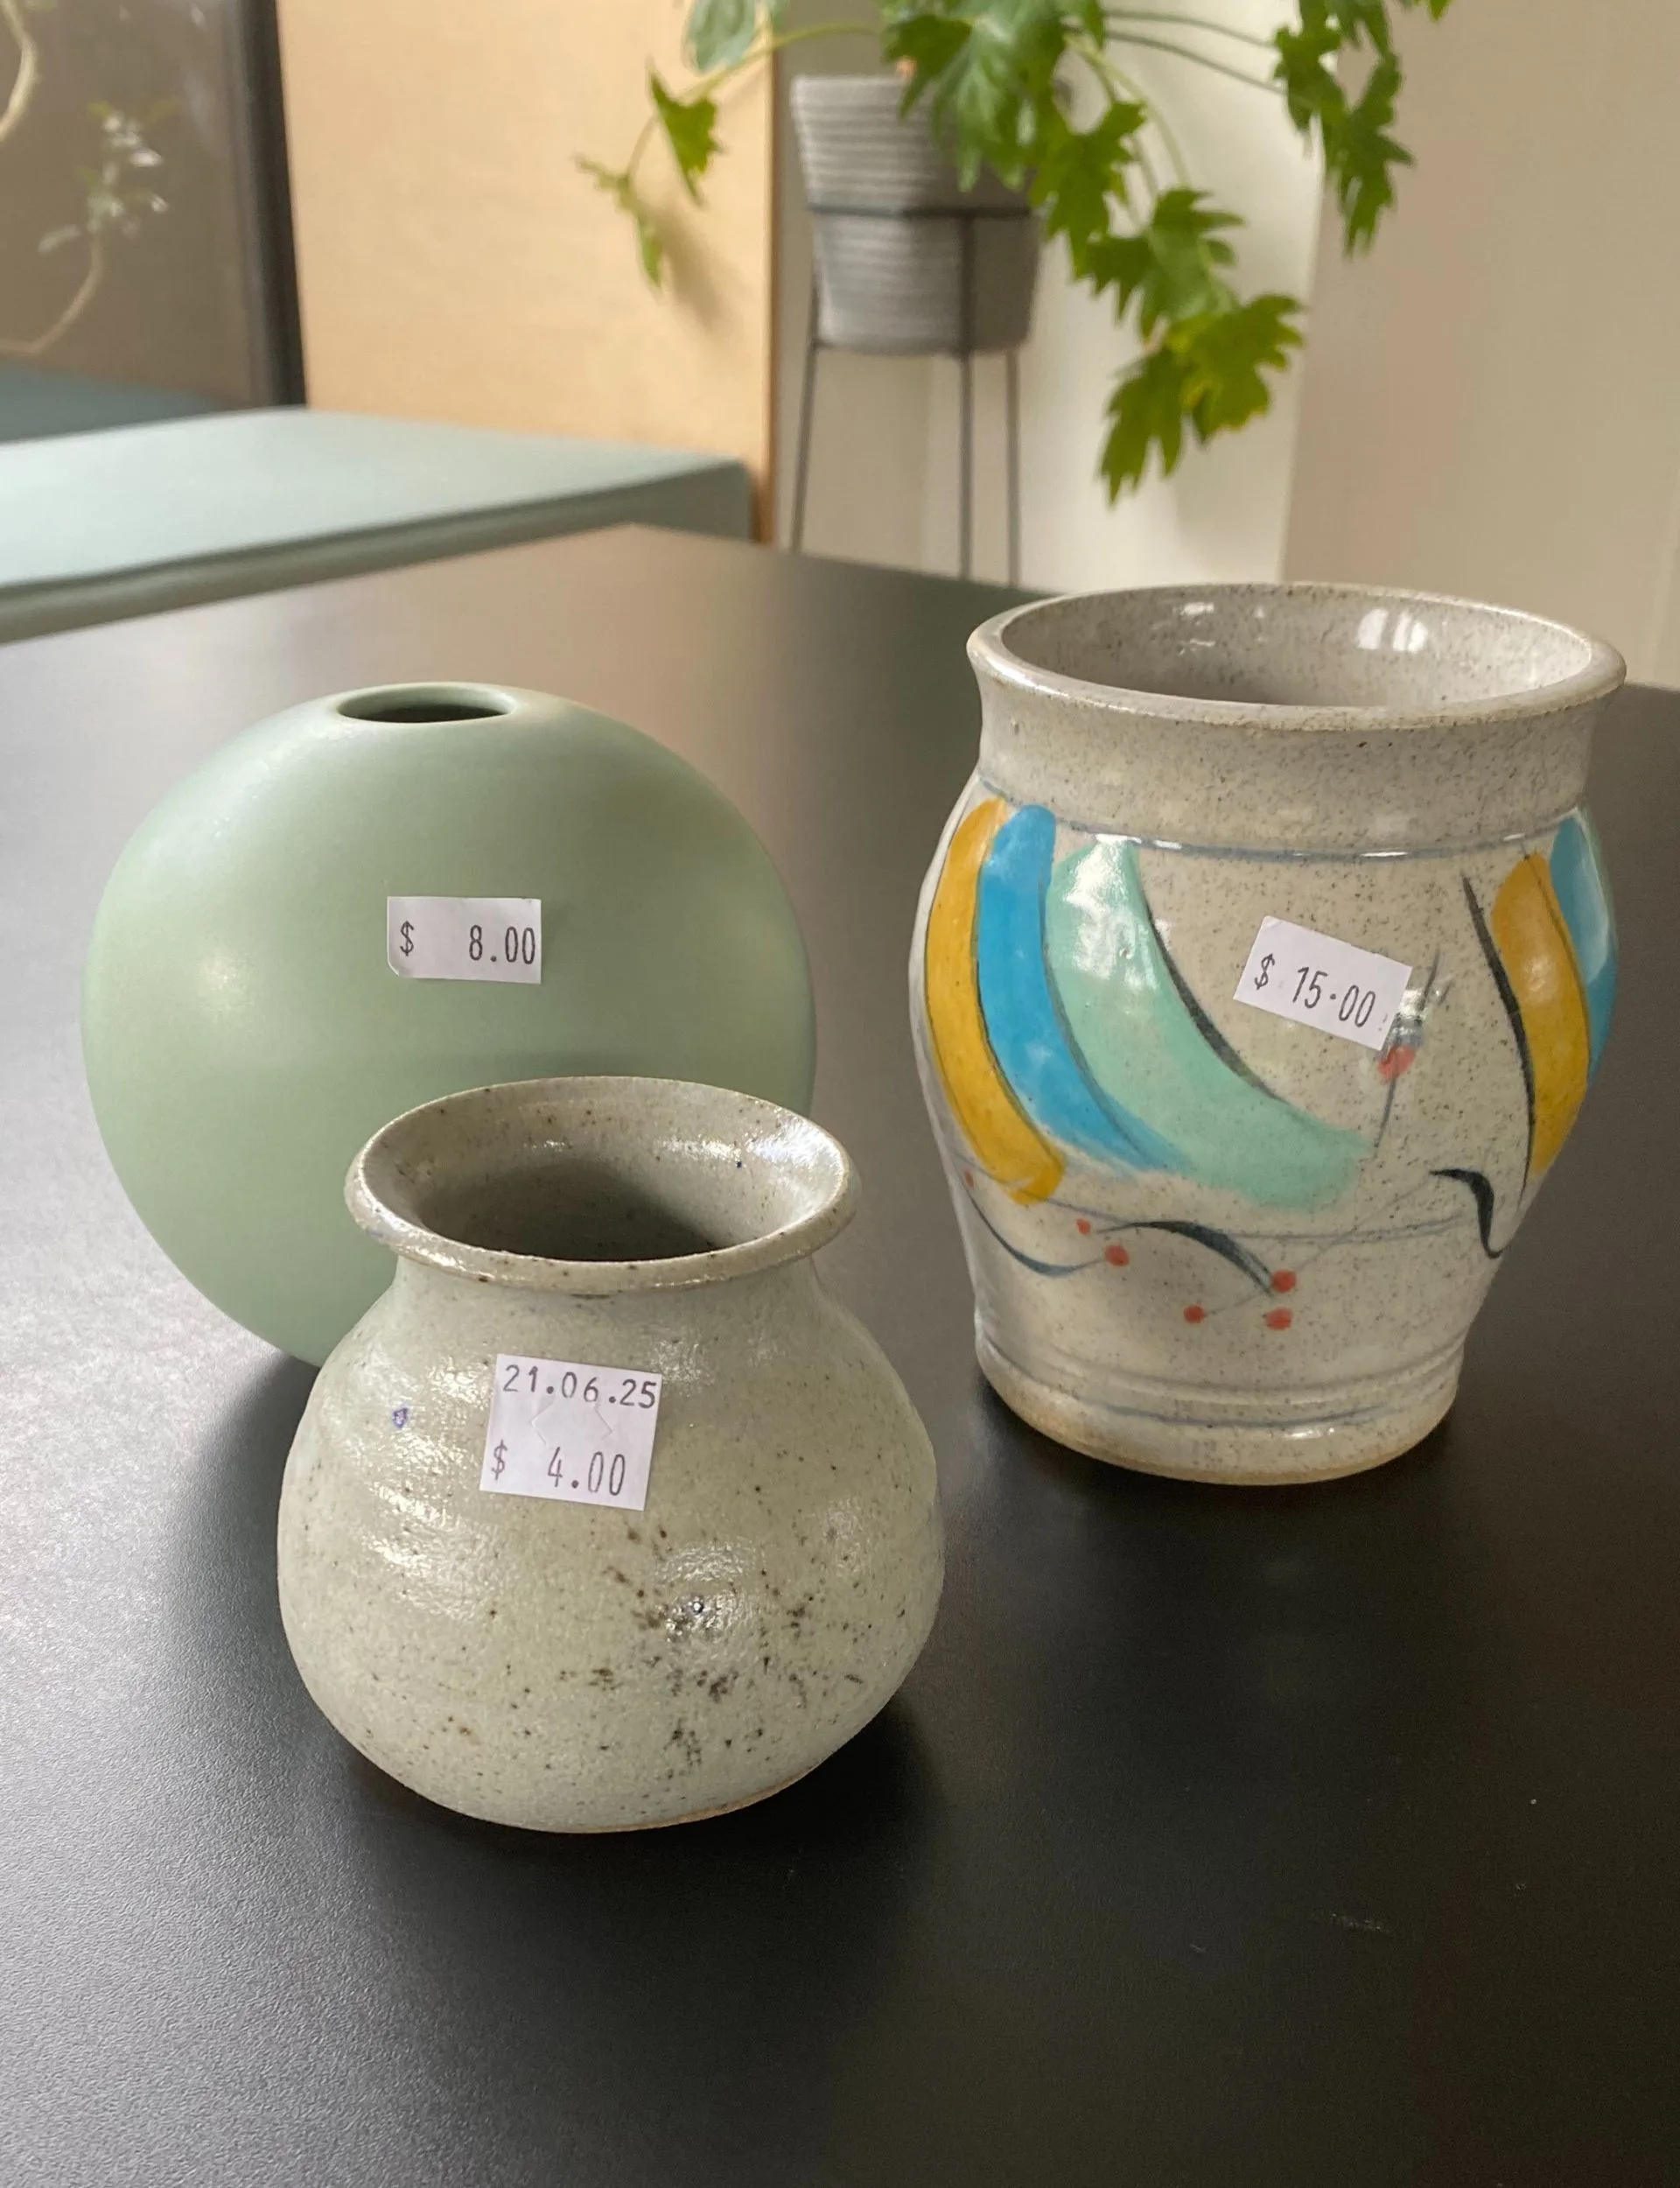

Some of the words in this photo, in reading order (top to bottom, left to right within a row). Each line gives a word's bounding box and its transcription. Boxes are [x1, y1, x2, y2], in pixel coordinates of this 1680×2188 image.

[400, 921, 414, 957] $
[469, 925, 536, 964] 8.00
[1255, 954, 1275, 990] $
[503, 1364, 656, 1408] 21.06.25
[491, 1439, 508, 1480] $
[548, 1447, 626, 1496] 4.00
